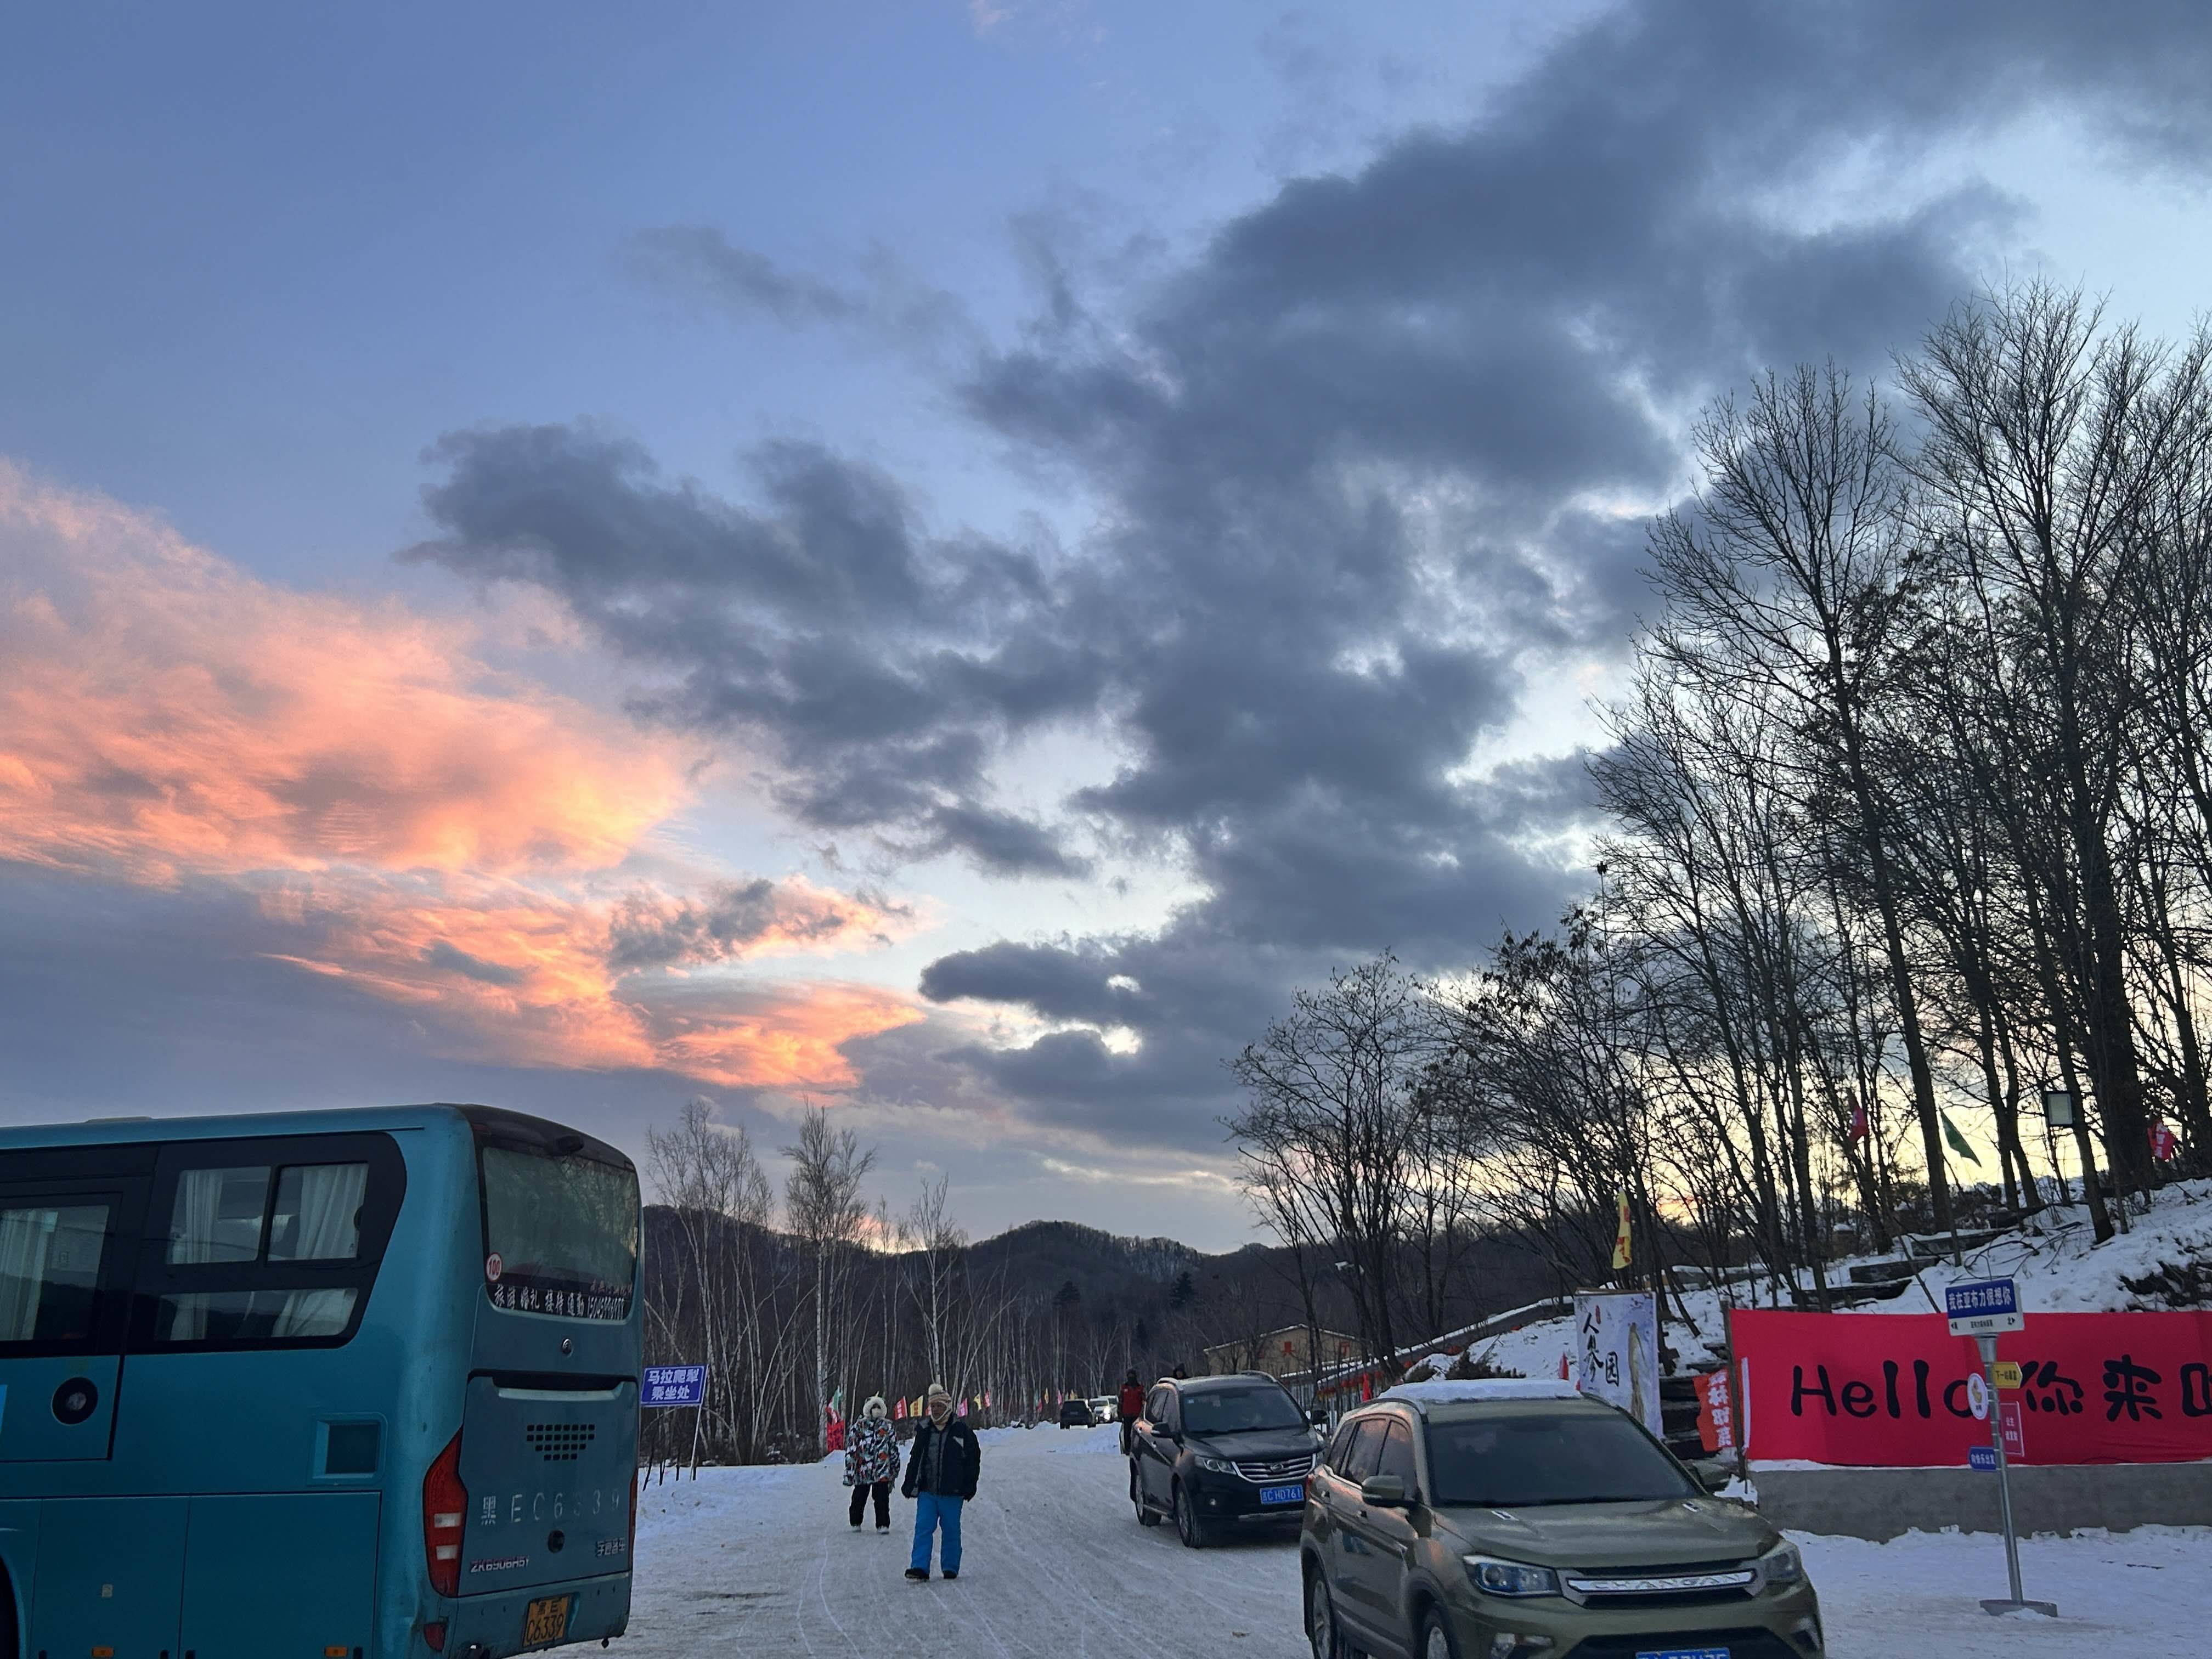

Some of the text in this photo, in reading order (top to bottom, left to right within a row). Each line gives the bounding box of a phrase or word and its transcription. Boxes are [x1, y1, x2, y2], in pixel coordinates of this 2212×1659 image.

[488, 1260, 500, 1276] 100
[1948, 1286, 2012, 1310] 我在亚布力很想你
[647, 1368, 699, 1385] 马拉爬犁
[651, 1385, 690, 1401] 乘坐处
[596, 1537, 626, 1557] 宇通客车
[1593, 1573, 1740, 1590] CHANGAN
[526, 1613, 565, 1643] C6339
